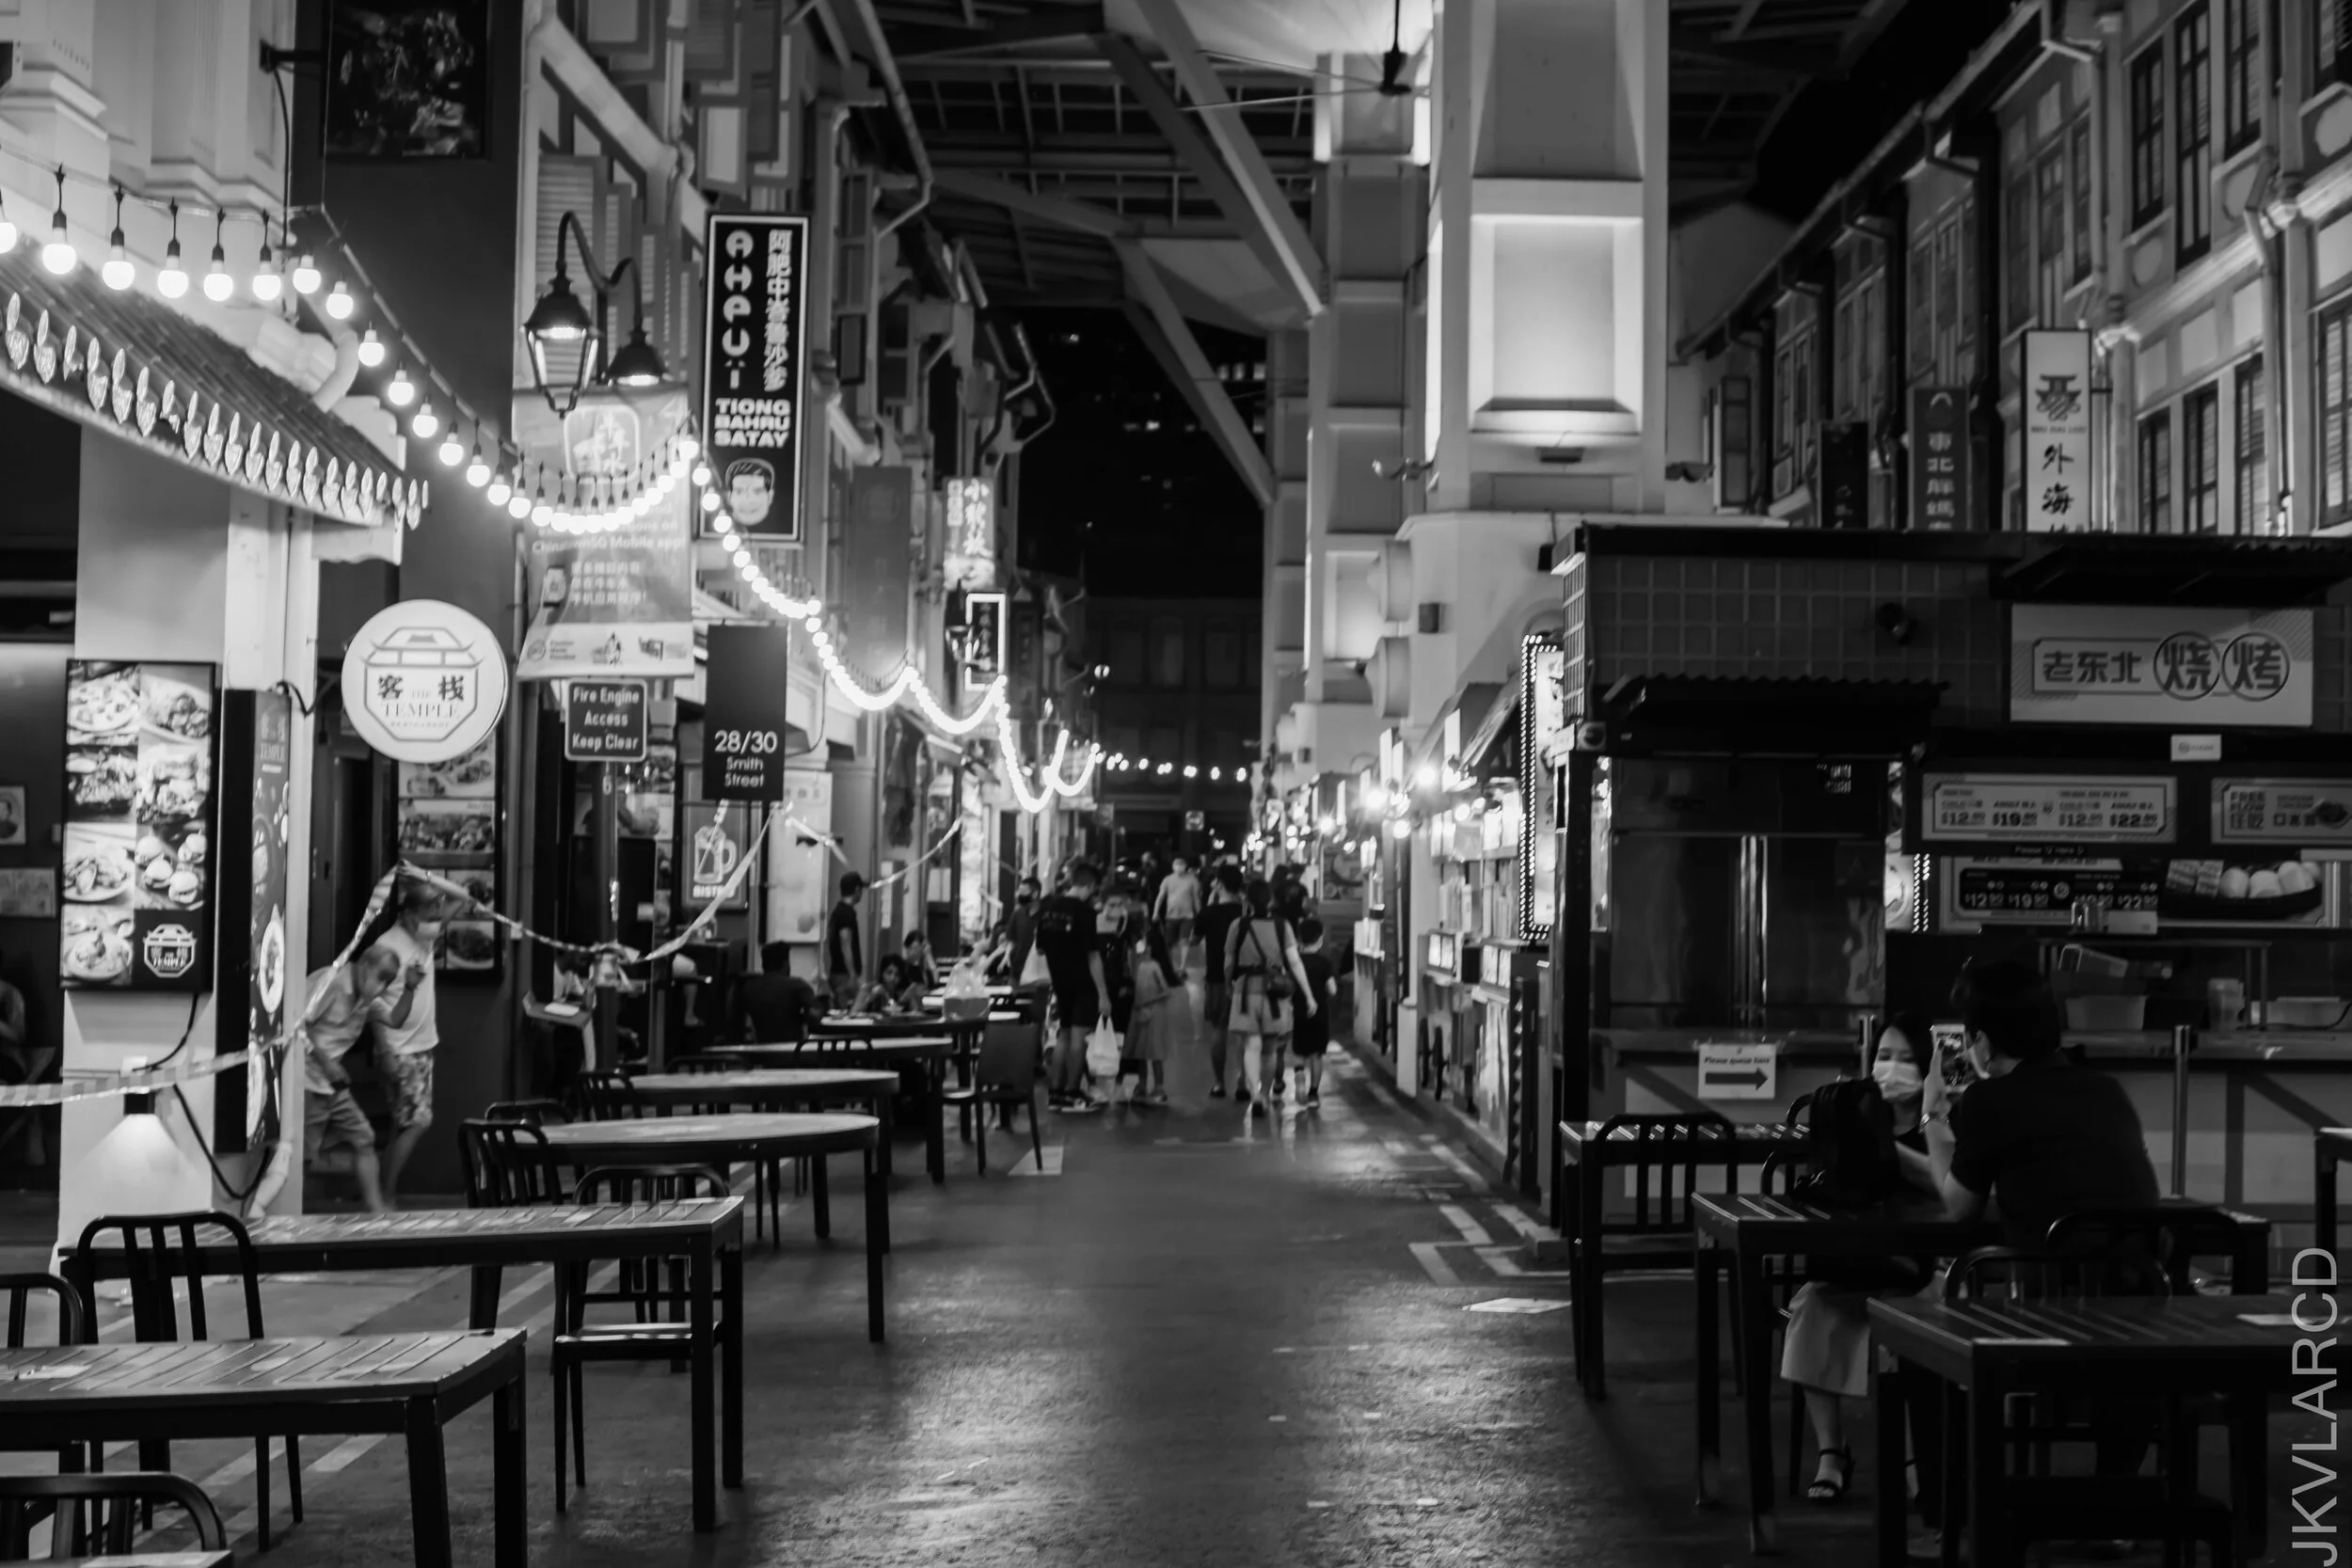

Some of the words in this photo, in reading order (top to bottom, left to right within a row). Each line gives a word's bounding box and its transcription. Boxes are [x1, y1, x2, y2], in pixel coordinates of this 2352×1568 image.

[715, 397, 791, 416] TIONG
[714, 413, 790, 431] BAHRU
[714, 430, 789, 448] SATAY
[2042, 649, 2143, 684] 老东北
[2164, 641, 2281, 691] 烧烤
[573, 686, 596, 704] Fire
[599, 686, 640, 708] Engine
[381, 703, 460, 718] TEMPLE
[583, 711, 628, 727] Access
[572, 733, 602, 752] Keep
[605, 734, 639, 750] Clear
[714, 729, 778, 754] 28/30
[725, 756, 764, 770] Smith
[723, 773, 765, 787] Street
[692, 884, 736, 898] BISTR
